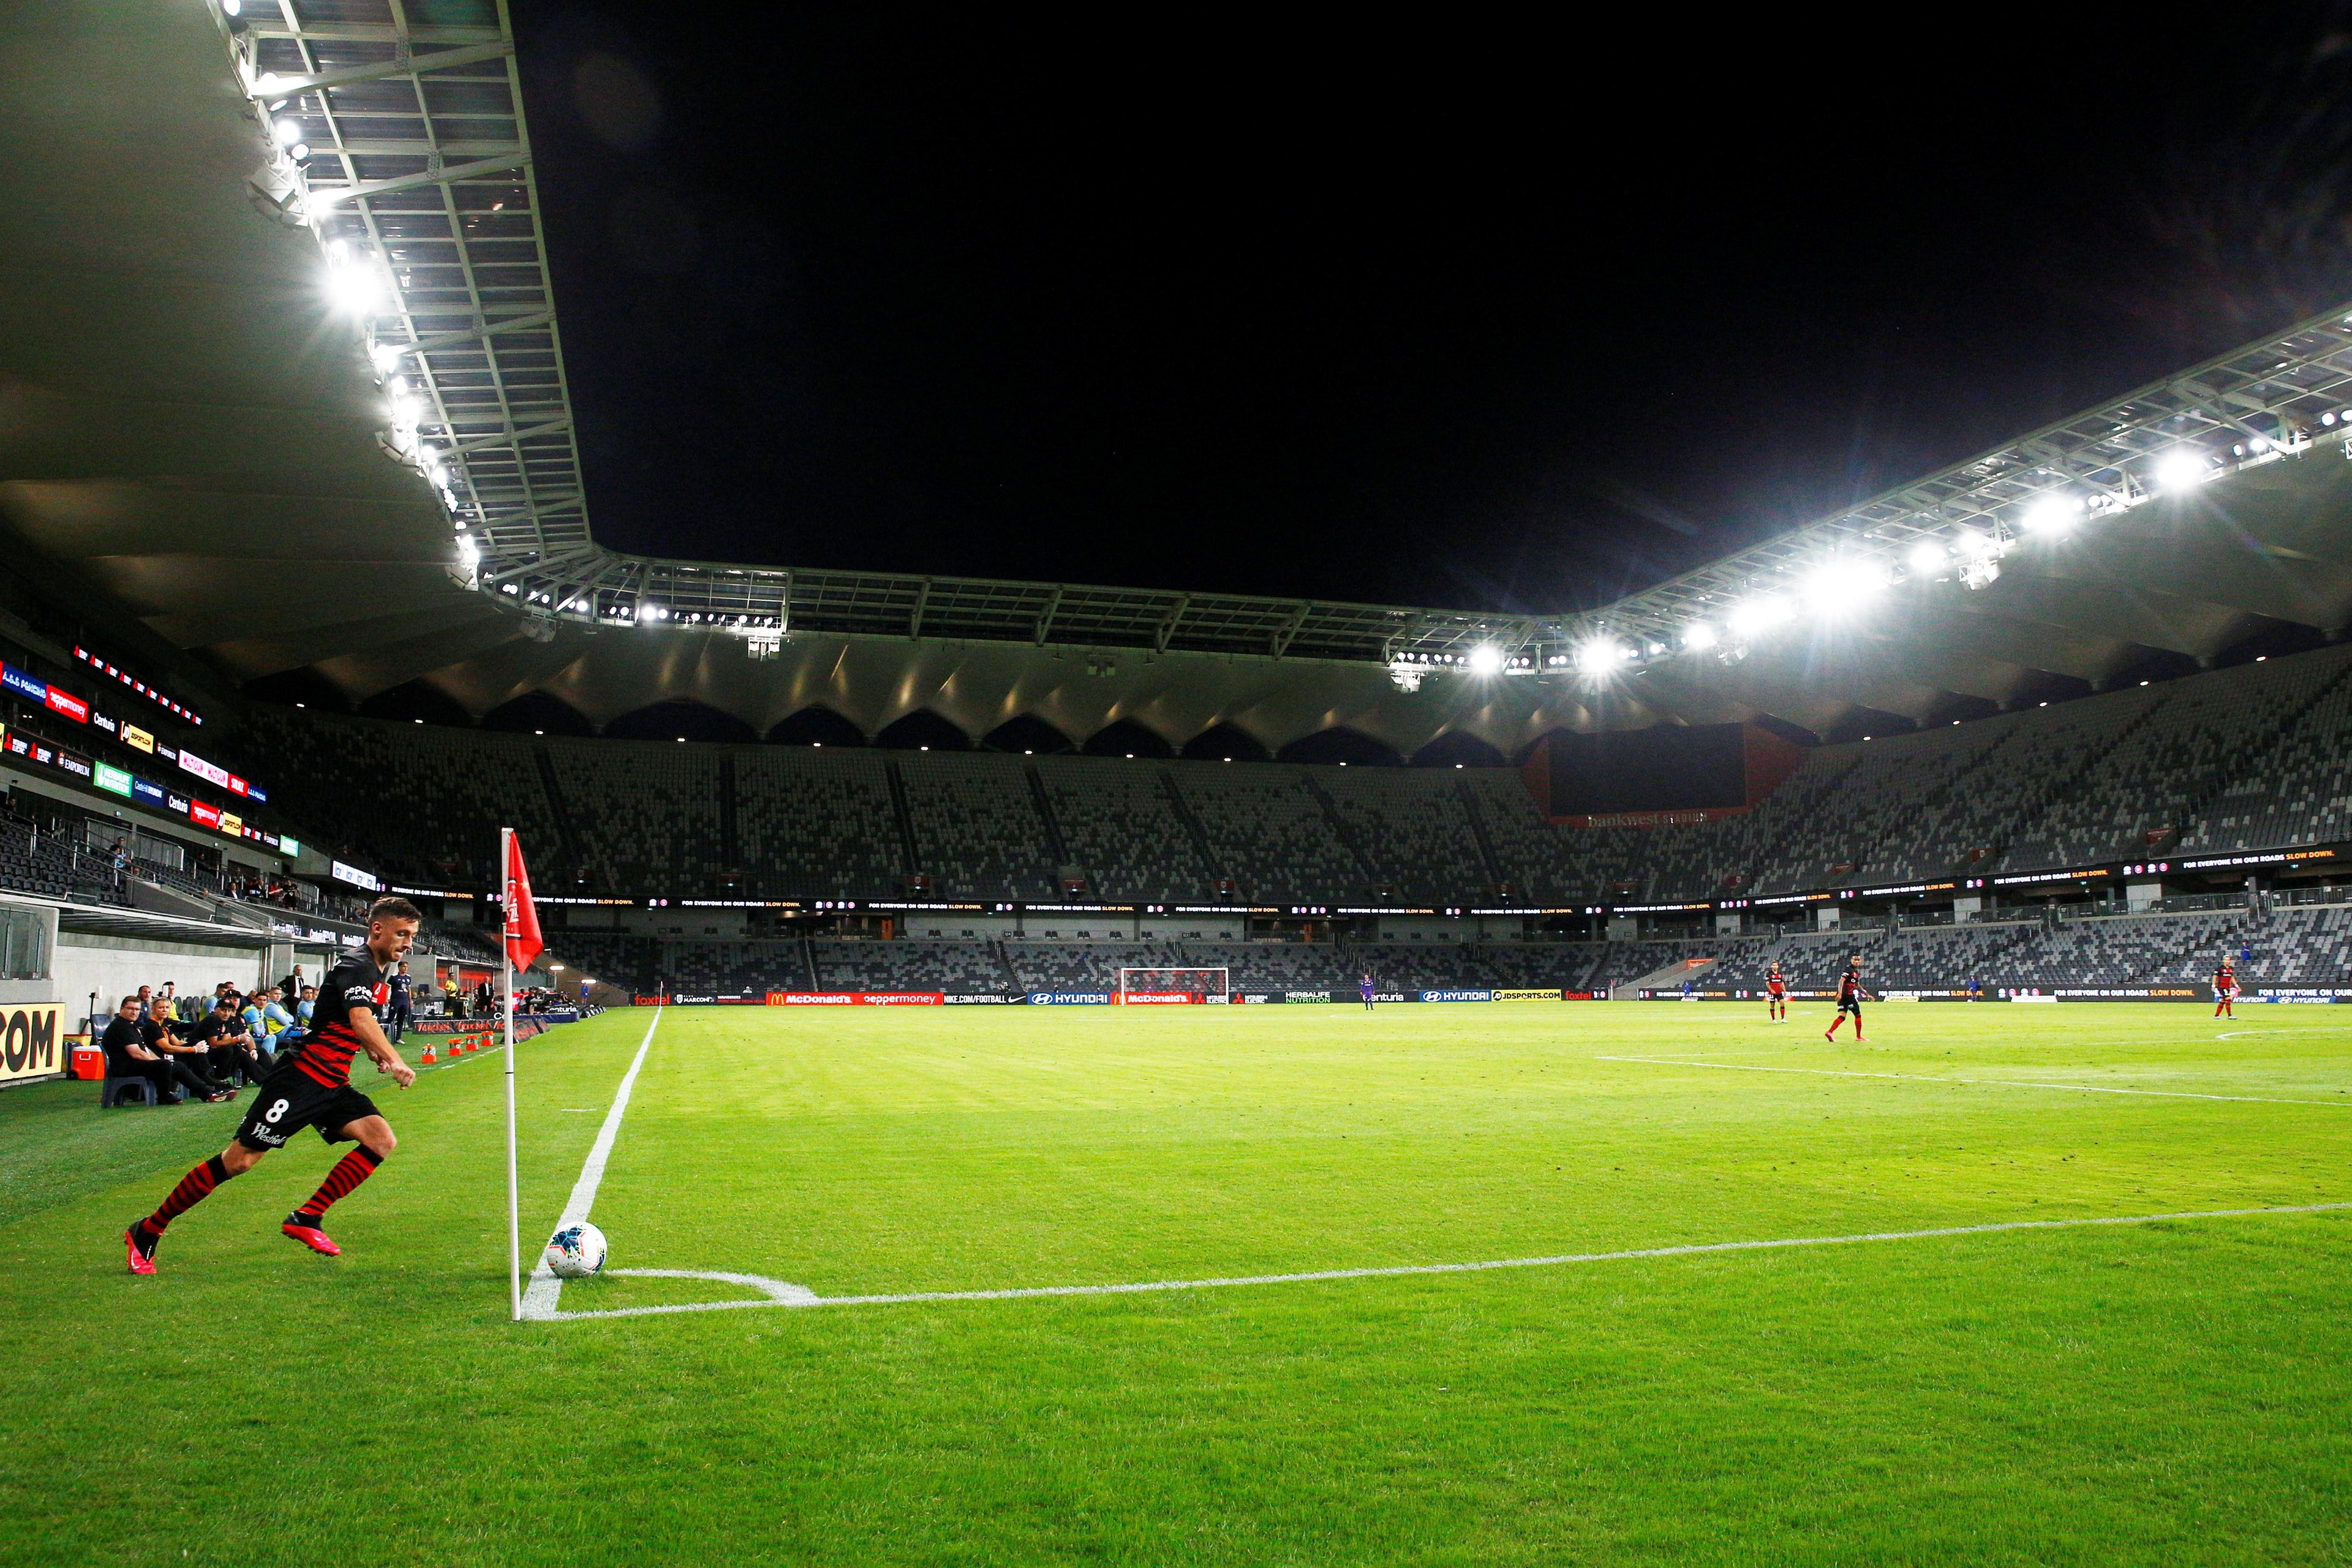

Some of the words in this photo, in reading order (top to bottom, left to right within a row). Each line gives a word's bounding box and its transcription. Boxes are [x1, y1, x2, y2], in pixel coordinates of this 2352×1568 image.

[65, 759, 90, 777] EMPORIUM
[168, 795, 188, 813] Centuria
[1588, 813, 1658, 827] bankwest
[2197, 858, 2231, 867] EVERYONE
[2260, 854, 2285, 862] ROADS
[635, 993, 671, 1005] foxtel
[786, 995, 852, 1004] McDonald's
[944, 995, 1006, 1004] NIKE.COM/FOOTBALL
[1055, 994, 1108, 1003] HYUNDAI
[1128, 994, 1188, 1003] McDonald's
[1444, 992, 1490, 1000] HYUNDAI
[1565, 990, 1592, 1000] foxtel
[265, 1098, 289, 1123] 8
